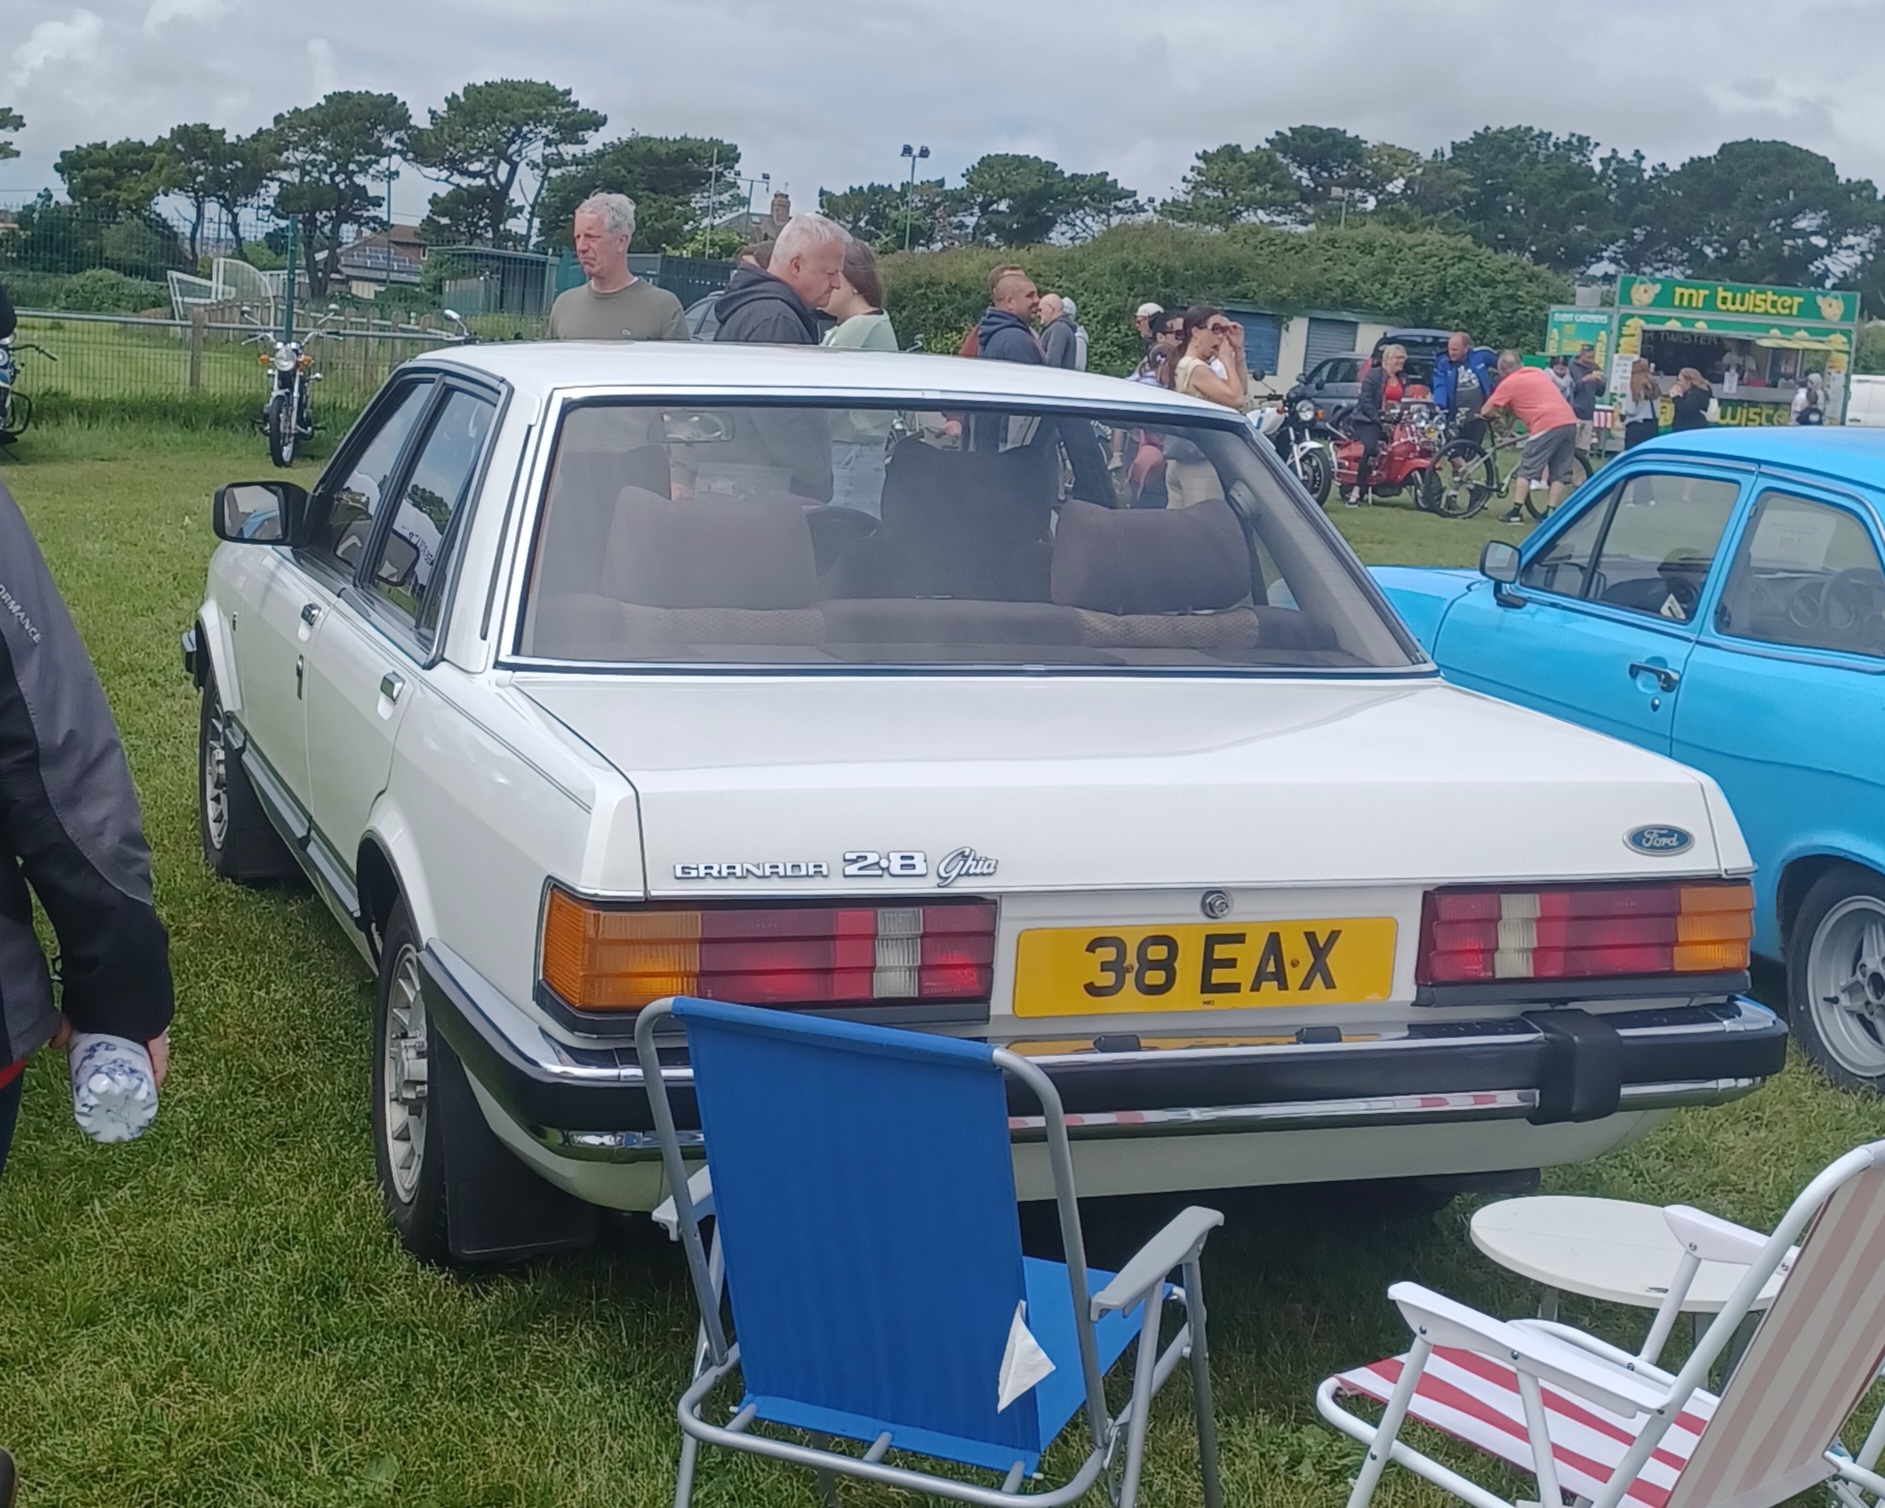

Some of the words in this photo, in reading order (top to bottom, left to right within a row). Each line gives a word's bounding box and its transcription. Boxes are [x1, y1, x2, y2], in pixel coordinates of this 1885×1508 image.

[1673, 286, 1710, 309] mr
[1715, 286, 1804, 316] twister
[1641, 829, 1679, 847] Ford
[674, 861, 830, 879] GRANADA
[936, 846, 999, 888] Ghia
[1083, 935, 1180, 997] 38
[1200, 930, 1343, 994] EAX
